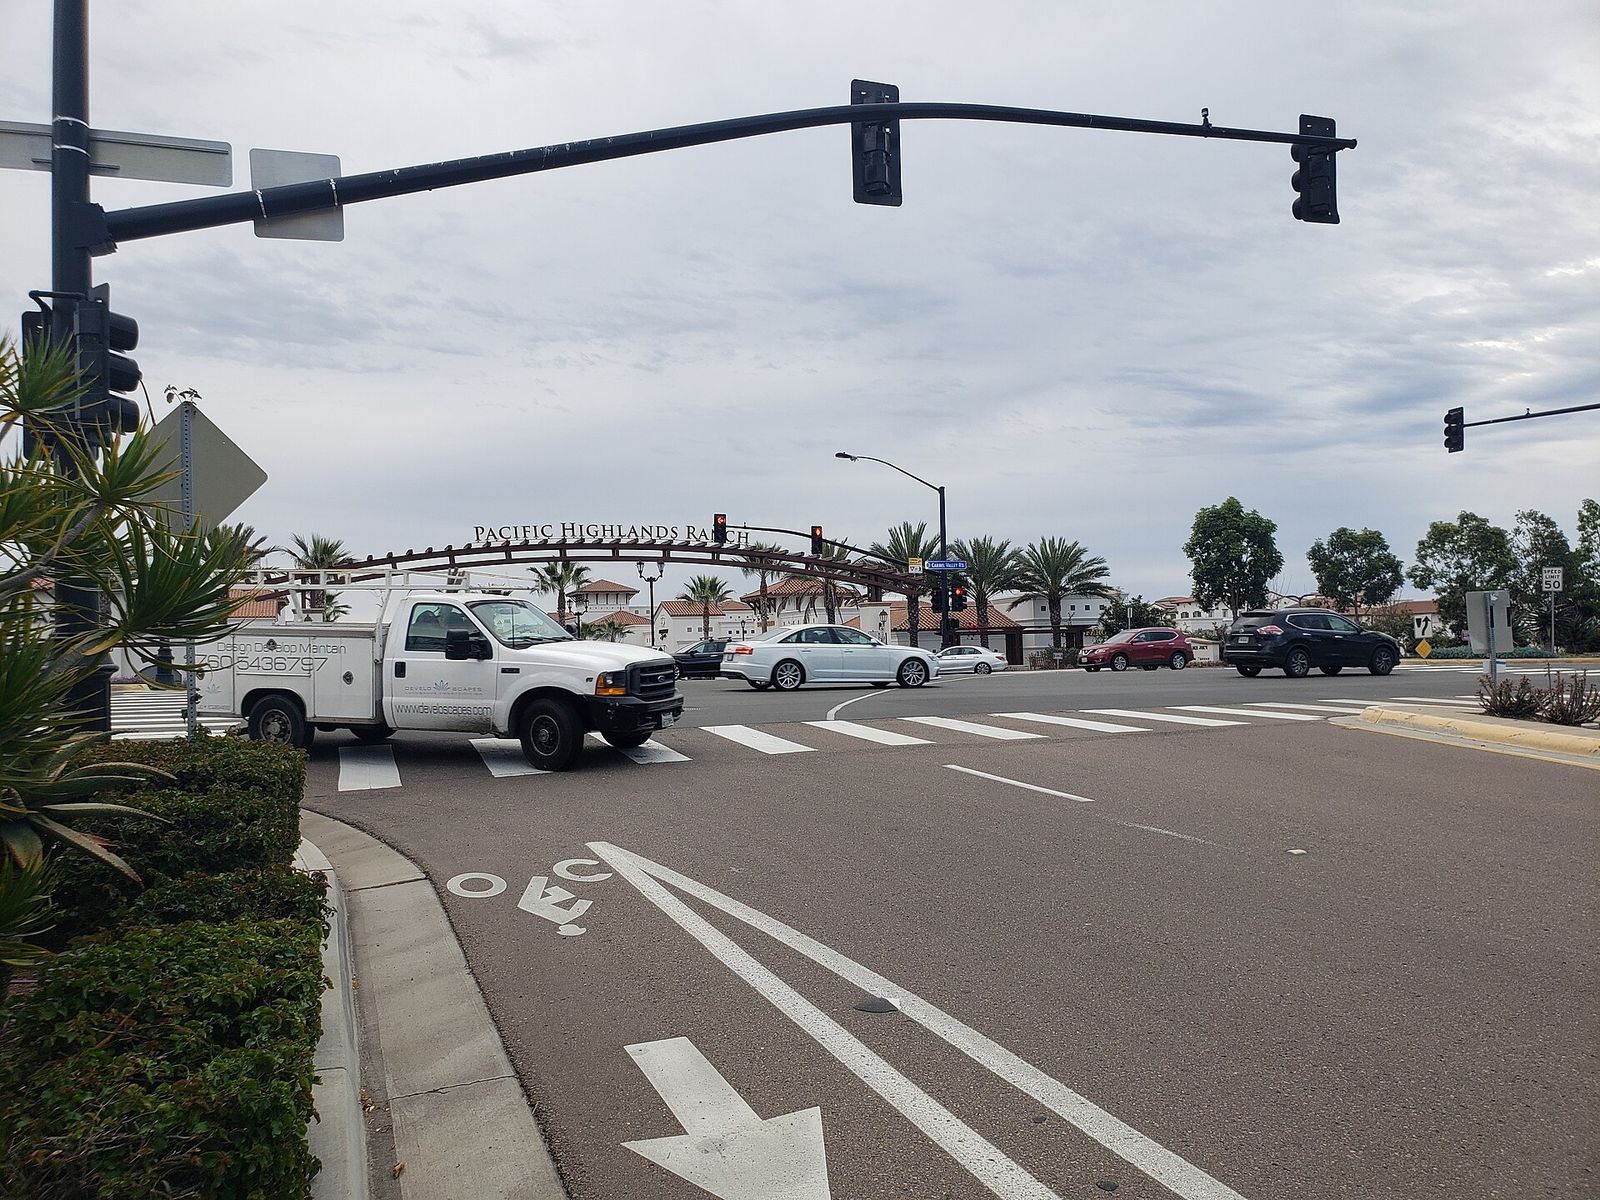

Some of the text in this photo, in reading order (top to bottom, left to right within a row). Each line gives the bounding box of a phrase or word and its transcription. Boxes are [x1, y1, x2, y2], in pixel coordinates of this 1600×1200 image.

[474, 525, 554, 541] PACIFIC
[560, 522, 679, 539] HIGHLANDS
[1544, 580, 1560, 589] 50
[254, 642, 298, 656] Deelop
